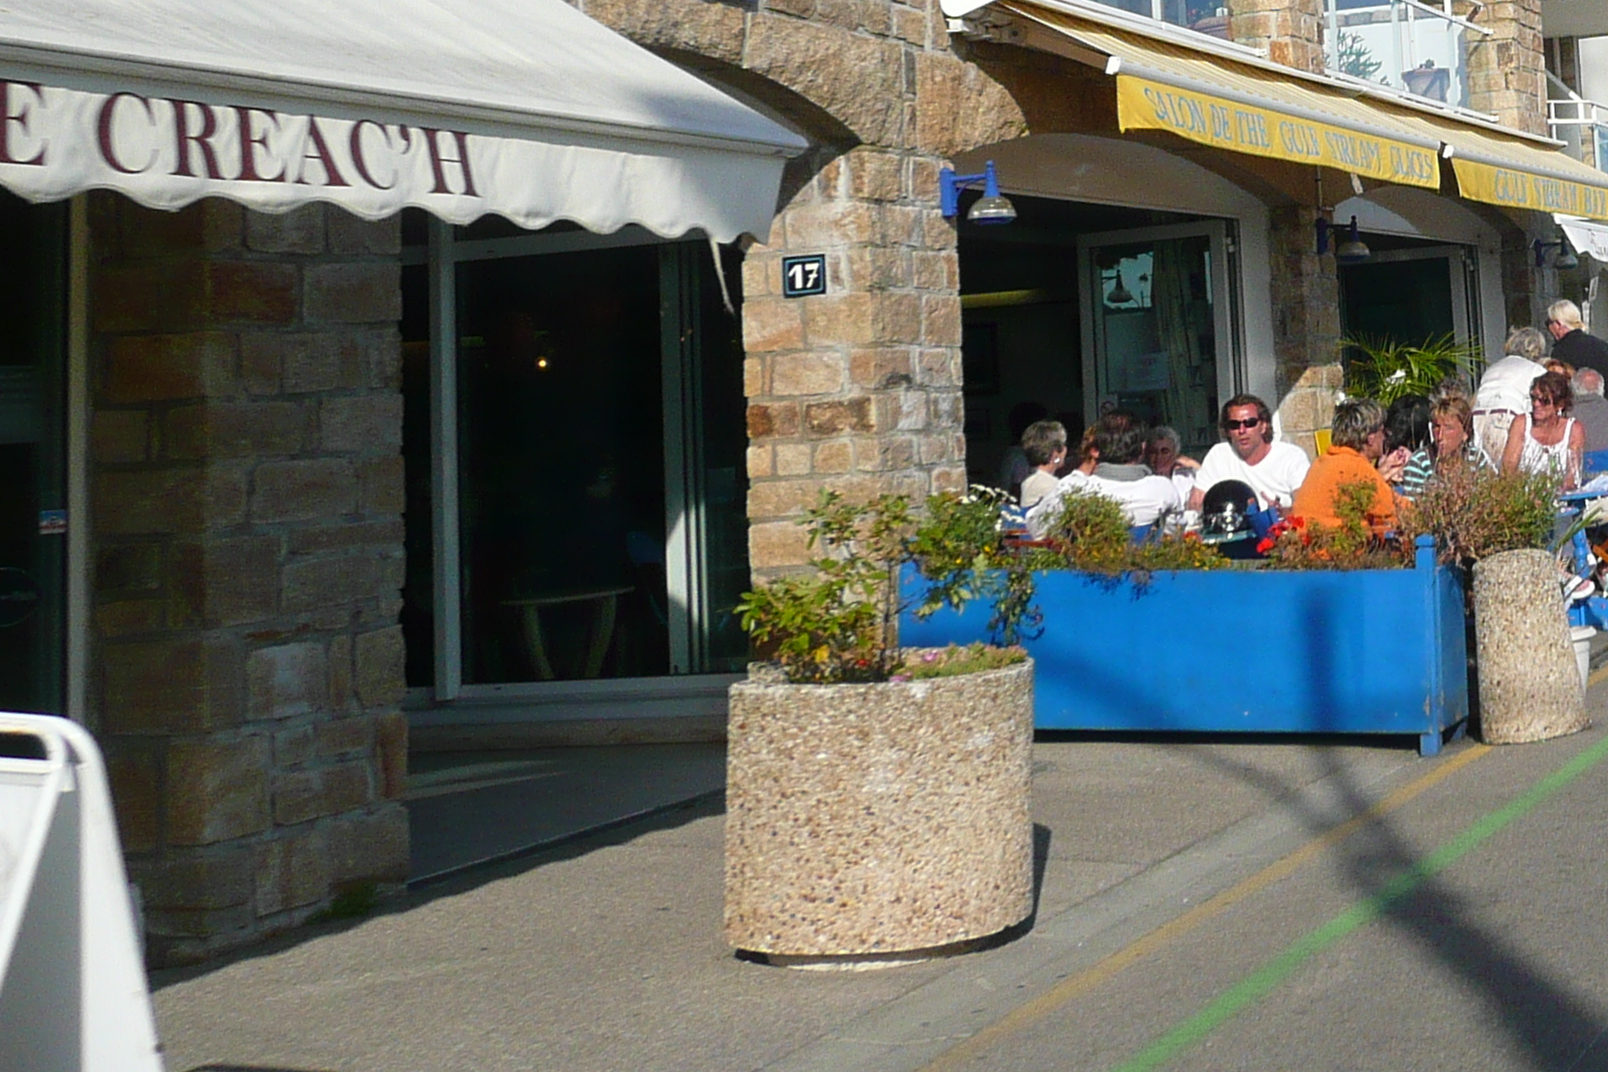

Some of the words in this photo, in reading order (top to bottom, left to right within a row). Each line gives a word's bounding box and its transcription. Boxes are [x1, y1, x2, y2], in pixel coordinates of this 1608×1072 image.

[98, 91, 483, 198] CREAC'H
[1143, 87, 1207, 134] SALON
[1209, 104, 1232, 141] DE
[1279, 121, 1321, 157] GULF
[788, 262, 820, 289] 17
